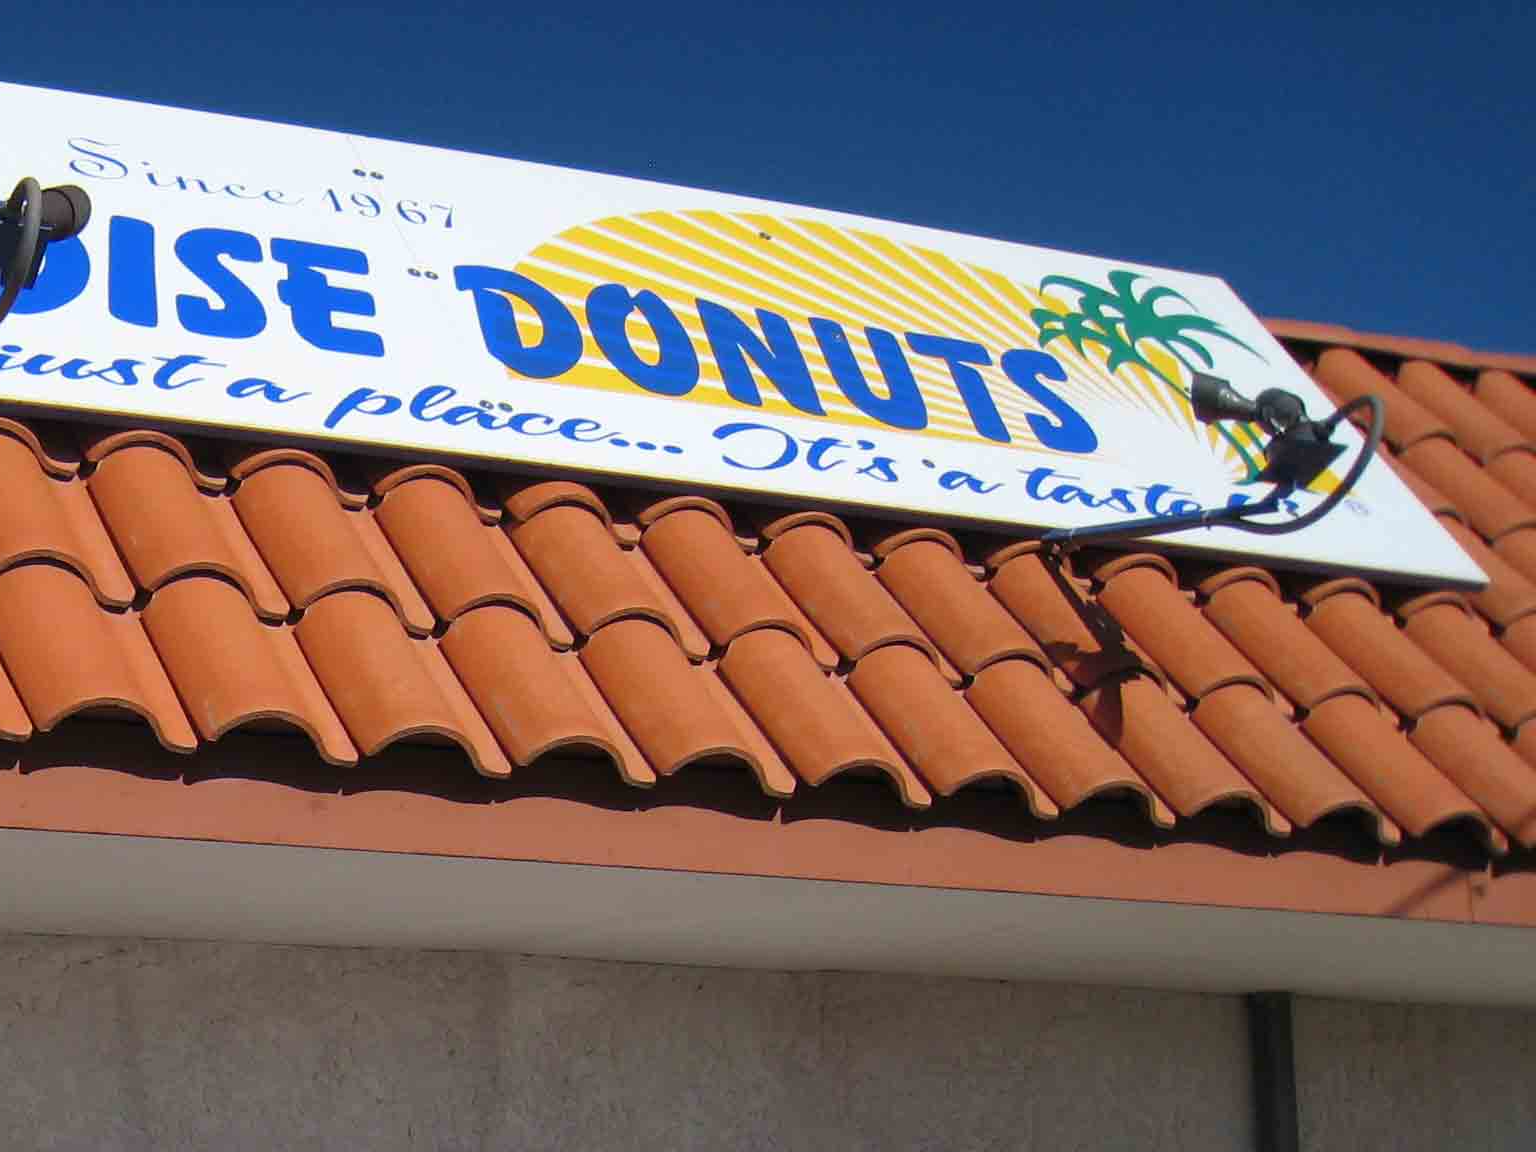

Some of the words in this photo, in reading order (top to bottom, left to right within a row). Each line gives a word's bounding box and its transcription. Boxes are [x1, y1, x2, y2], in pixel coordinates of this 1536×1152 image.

[67, 136, 305, 206] Since
[322, 187, 456, 229] 1967
[453, 265, 1098, 453] DONUTS
[226, 377, 311, 403] a
[937, 469, 1006, 495] a
